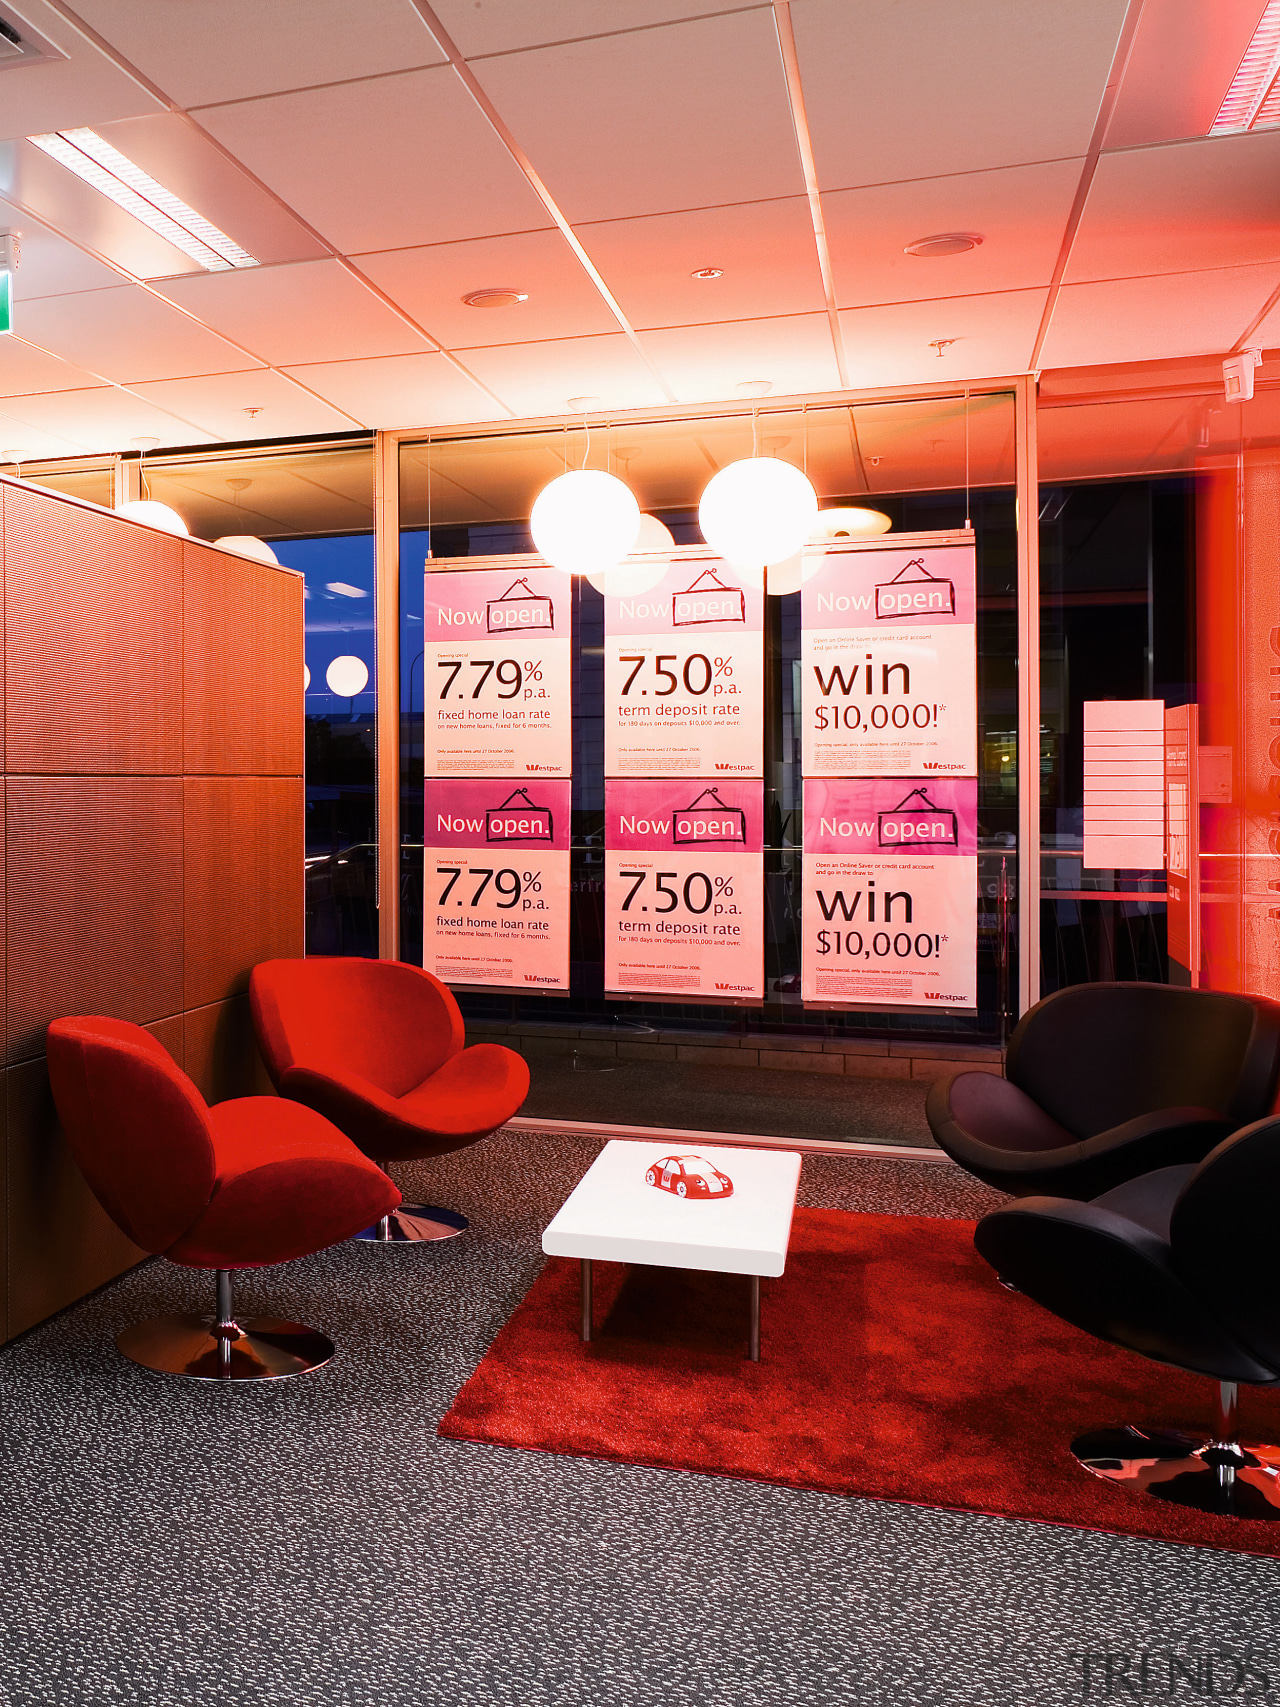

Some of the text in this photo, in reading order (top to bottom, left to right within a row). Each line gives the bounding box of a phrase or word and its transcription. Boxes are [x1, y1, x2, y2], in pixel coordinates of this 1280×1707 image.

[817, 591, 950, 612] Now open.
[437, 607, 550, 627] Now open.
[619, 600, 741, 620] Now open.
[813, 653, 910, 696] win
[523, 688, 551, 702] p.a.
[713, 684, 742, 697] p.a.
[437, 708, 551, 720] fixed home loan rate
[618, 703, 740, 718] term deposit rate
[525, 764, 563, 772] Westpac
[714, 763, 755, 771] Westpac
[922, 762, 966, 770] Westpac
[437, 813, 550, 837] Now open.
[620, 815, 742, 839] Now open.
[820, 817, 954, 842] Now open.
[522, 899, 550, 911] p.a.
[815, 880, 913, 924] win
[713, 903, 742, 916] p.a.
[436, 916, 549, 930] fixed home loan rate
[618, 920, 741, 935] term deposit rate
[639, 936, 653, 944] days
[663, 937, 688, 945] deposits
[689, 938, 713, 946] $10,000
[524, 974, 561, 984] Westpac
[714, 983, 755, 992] Westpac
[924, 992, 968, 1002] Westpac
